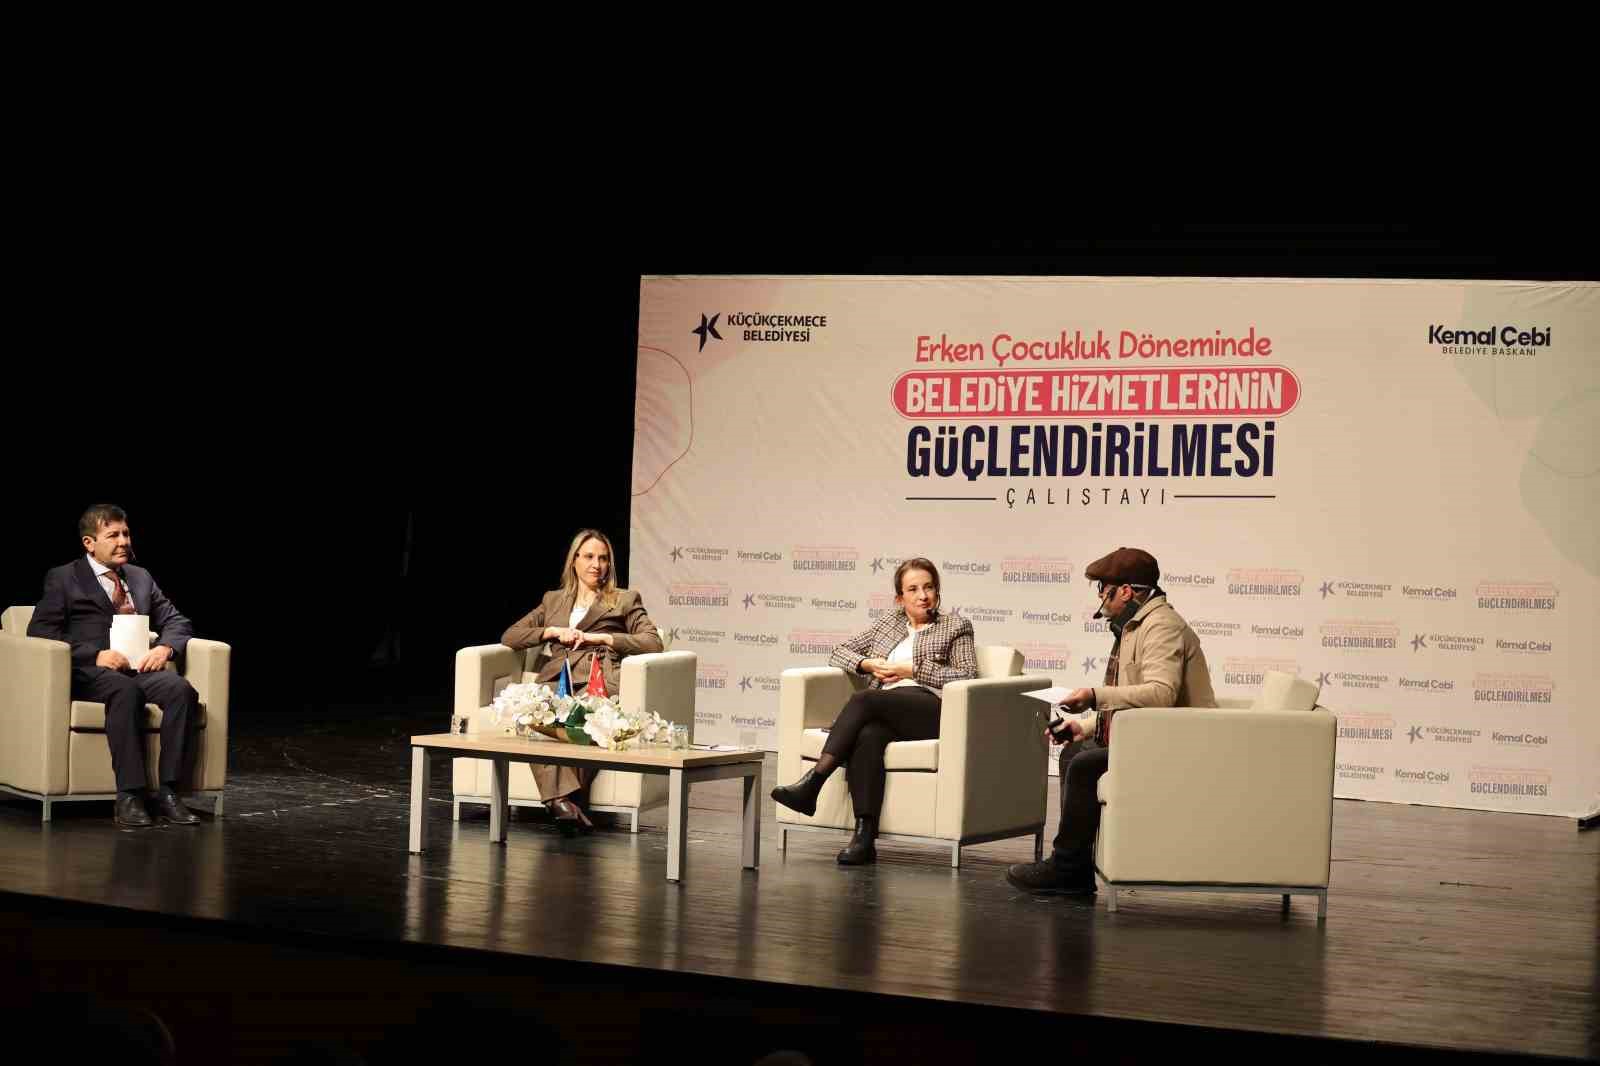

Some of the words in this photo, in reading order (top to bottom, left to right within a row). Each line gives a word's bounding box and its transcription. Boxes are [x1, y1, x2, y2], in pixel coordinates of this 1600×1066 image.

[727, 313, 827, 330] KÜÇÜKÇEKMECE
[743, 327, 810, 342] BELEDİYESİ
[1429, 324, 1496, 345] Kemal
[1500, 326, 1551, 347] Çebi
[915, 335, 984, 362] Erken
[992, 330, 1111, 366] Çocukluk
[1119, 327, 1272, 358] Döneminde
[906, 373, 1043, 413] BELEDİYE
[906, 421, 1276, 481] GÜÇLENDİRİLMESİ
[1006, 488, 1165, 508] ÇALIŞTAYI
[1402, 585, 1433, 597] Kemal
[1496, 639, 1527, 650] Kemal
[1400, 678, 1429, 689] Kemal
[1492, 732, 1523, 743] Kemal
[1395, 768, 1426, 779] Kemal
